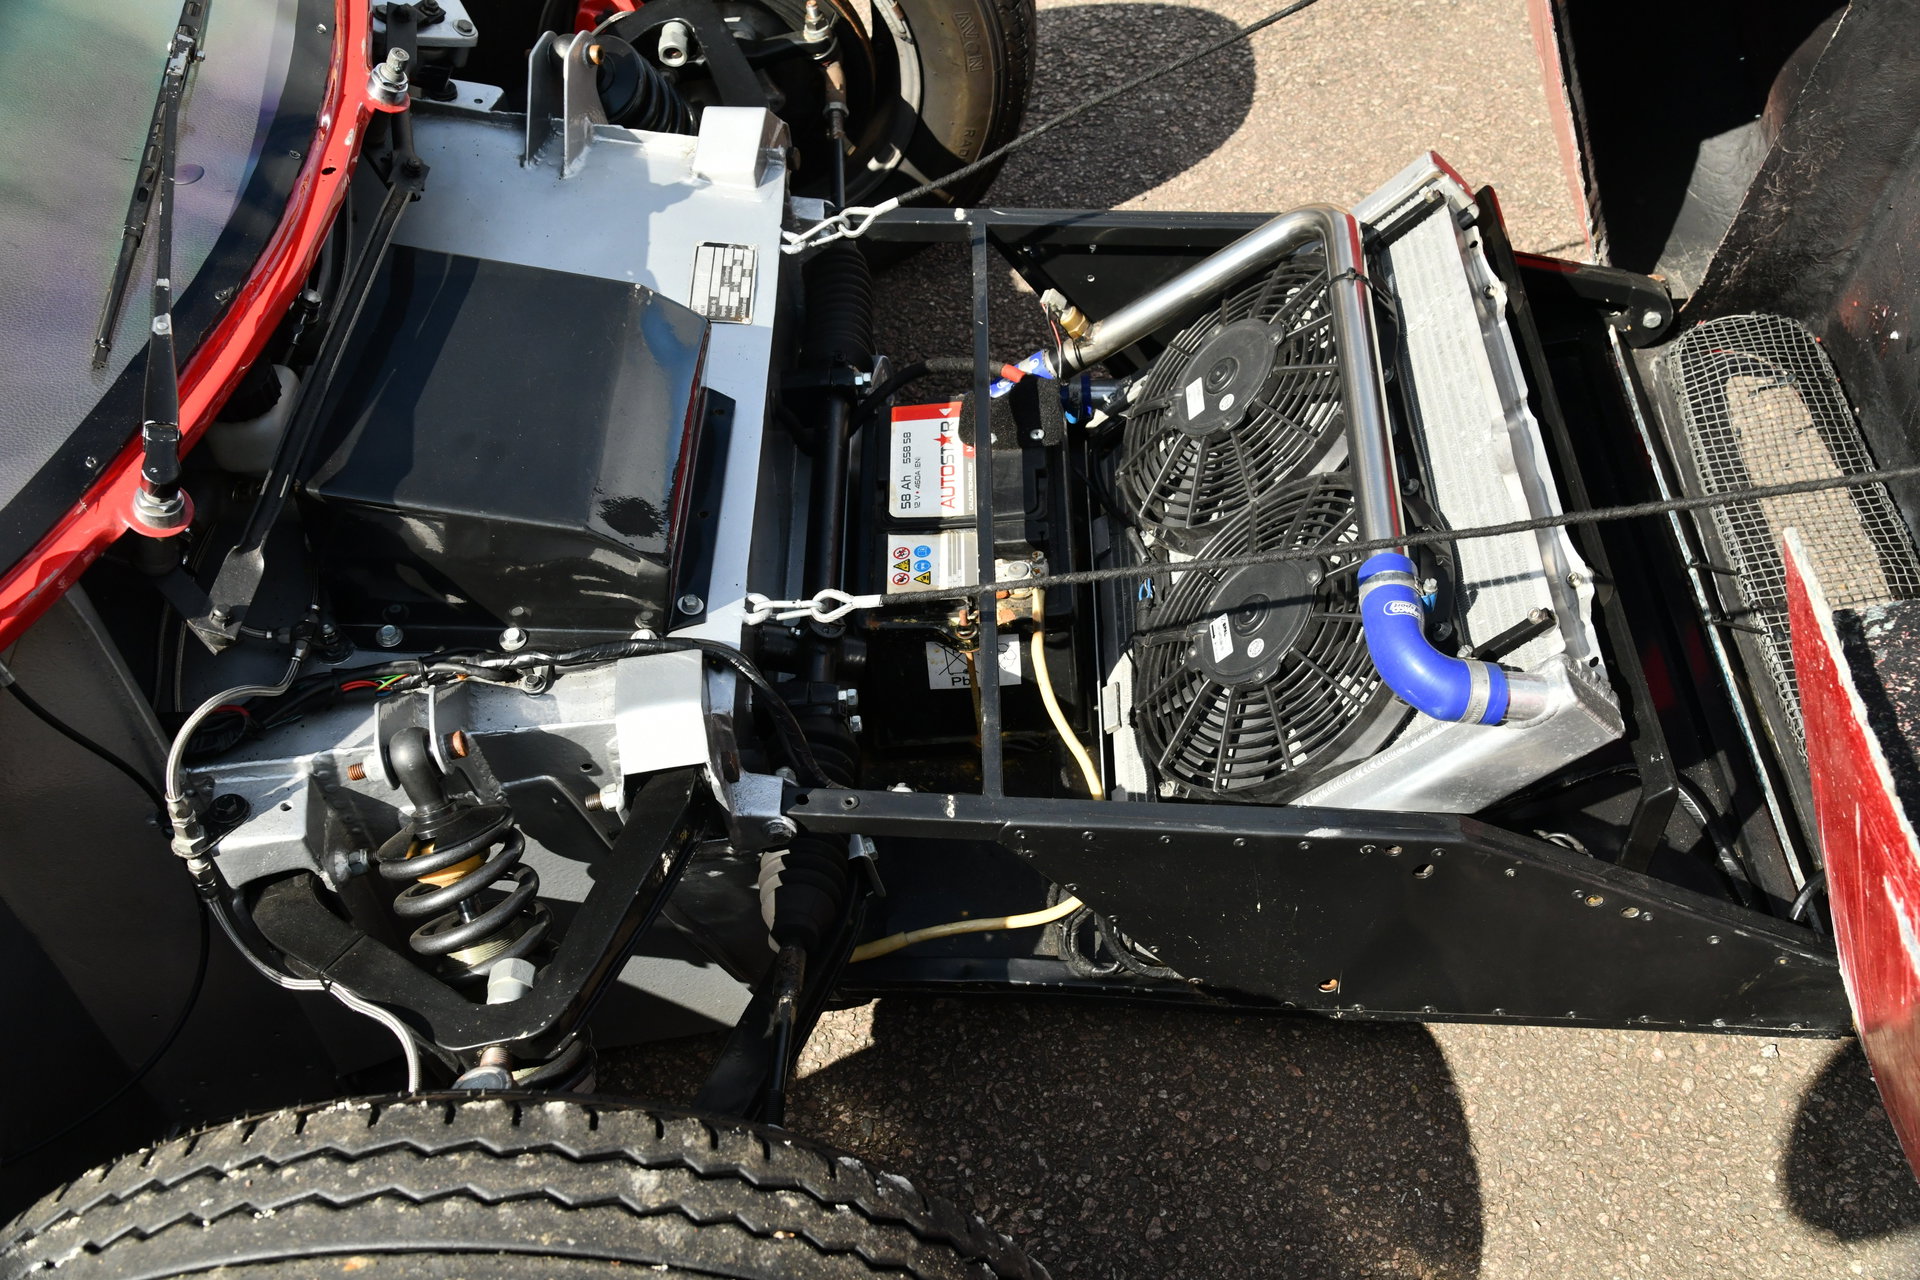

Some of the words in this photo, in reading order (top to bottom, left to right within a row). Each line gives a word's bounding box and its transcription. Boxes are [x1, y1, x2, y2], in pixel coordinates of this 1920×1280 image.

[954, 11, 985, 72] AVON
[902, 431, 911, 444] 58
[902, 445, 911, 464] 558
[901, 475, 911, 491] Ah
[901, 494, 911, 510] 58
[951, 676, 971, 687] Pb
